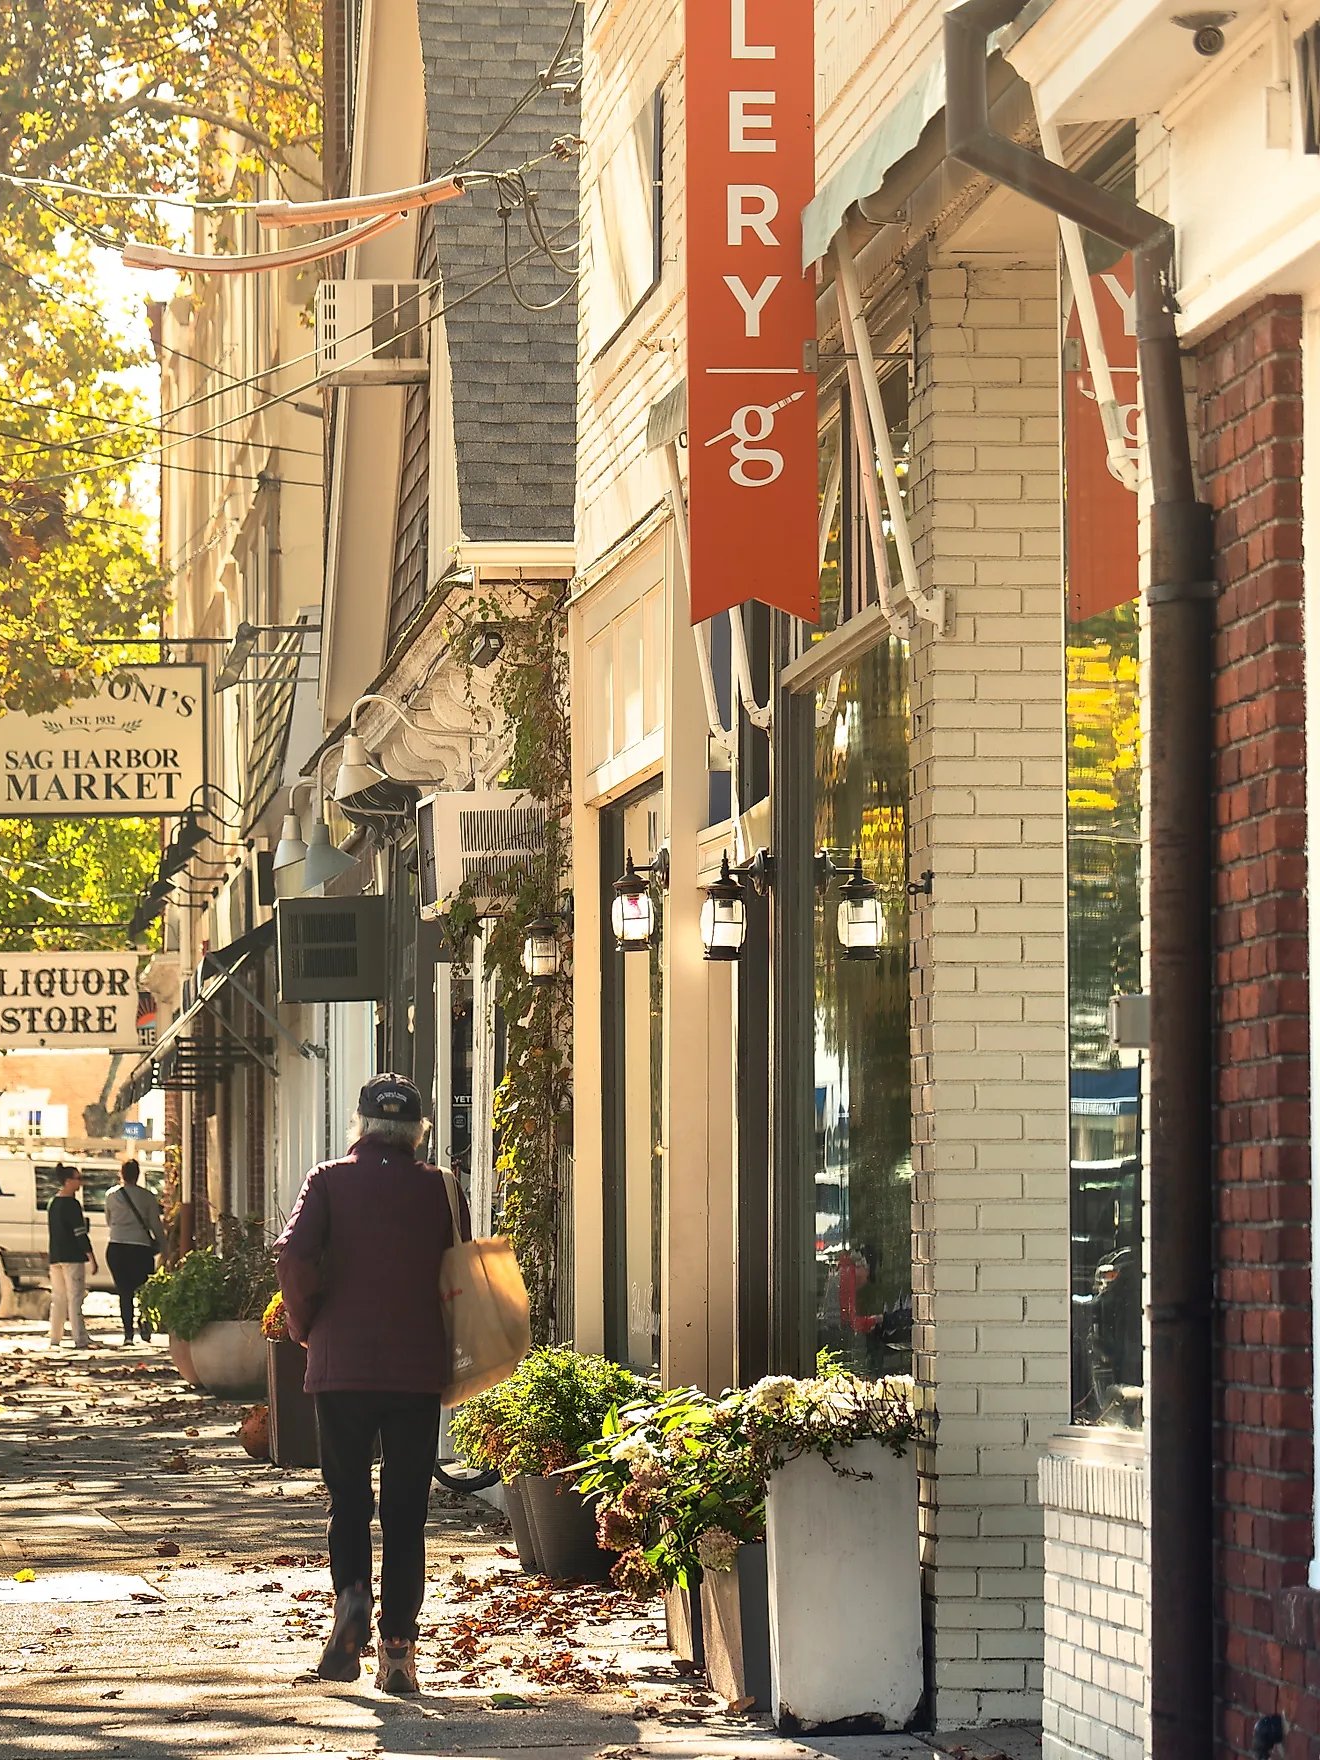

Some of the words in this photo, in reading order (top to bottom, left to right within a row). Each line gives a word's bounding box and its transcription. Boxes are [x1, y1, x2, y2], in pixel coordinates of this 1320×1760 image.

[69, 716, 91, 725] EST.
[95, 716, 115, 725] 1932
[5, 750, 53, 770] SAG
[63, 748, 180, 769] HARBOR
[5, 772, 182, 802] MARKET
[0, 1005, 117, 1033] STORE
[453, 1095, 473, 1103] YET
